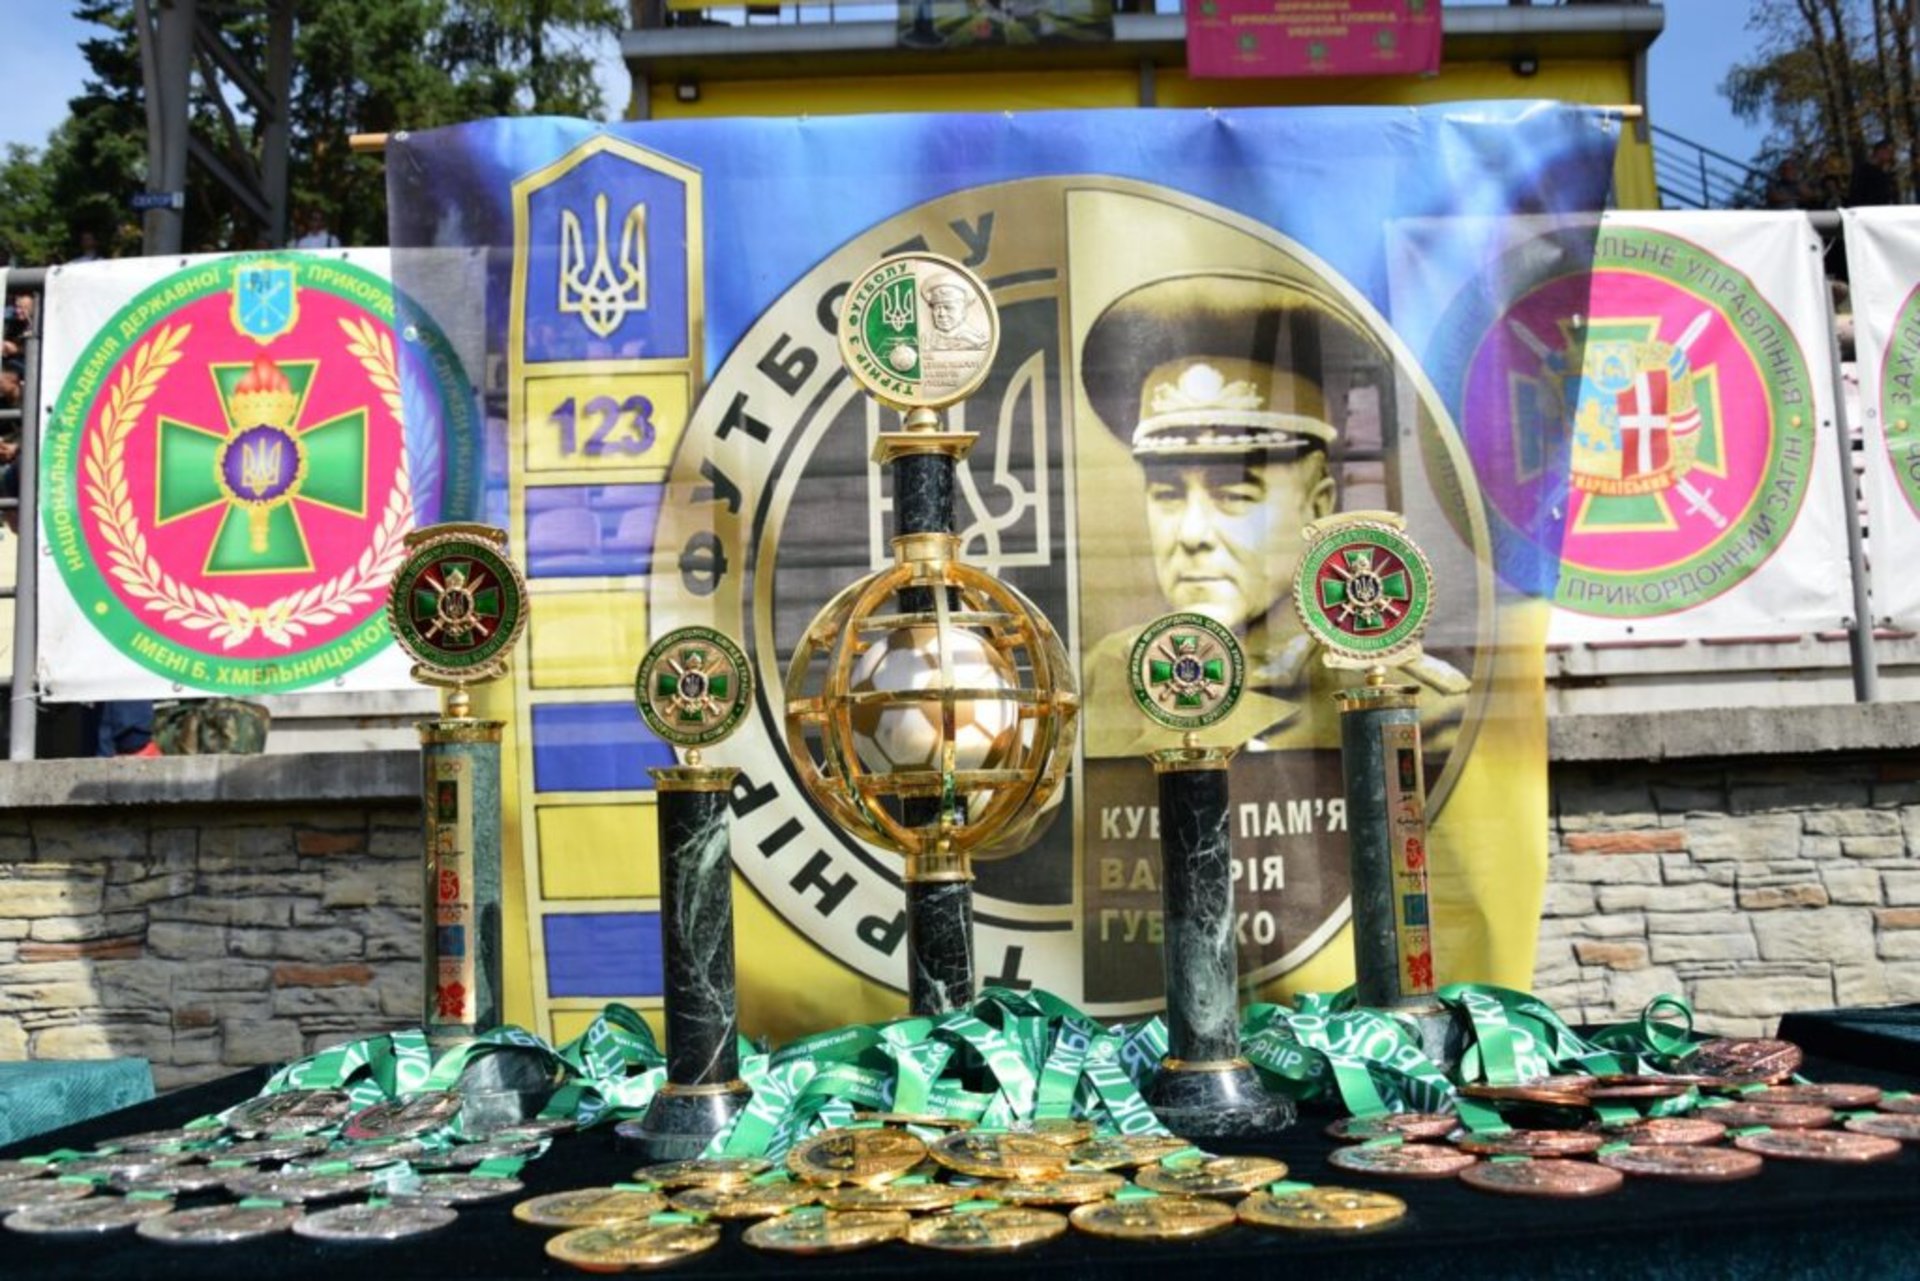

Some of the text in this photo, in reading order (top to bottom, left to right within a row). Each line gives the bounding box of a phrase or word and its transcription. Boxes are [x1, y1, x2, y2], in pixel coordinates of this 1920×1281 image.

[119, 267, 221, 341] ДЕРЖАВНОЇ
[848, 262, 908, 327] ФУТБОЛУ
[1593, 236, 1803, 406] ЛЬНЕ УПРАВЛІННЯ
[63, 335, 121, 428] АКАДЕМІЯ
[676, 211, 995, 597] ФУТБОУ
[856, 353, 914, 396] ТУРНІР
[548, 394, 656, 457] 123
[52, 431, 86, 572] НАЦІОНАЛЬНА
[1767, 436, 1802, 512] ЗАГІН
[131, 614, 389, 686] ІМЕНІ Б. ХМЕЛЬНИЦЬКОГ
[1239, 798, 1348, 838] ПАМ’Я
[729, 770, 1031, 990] ТРНІР
